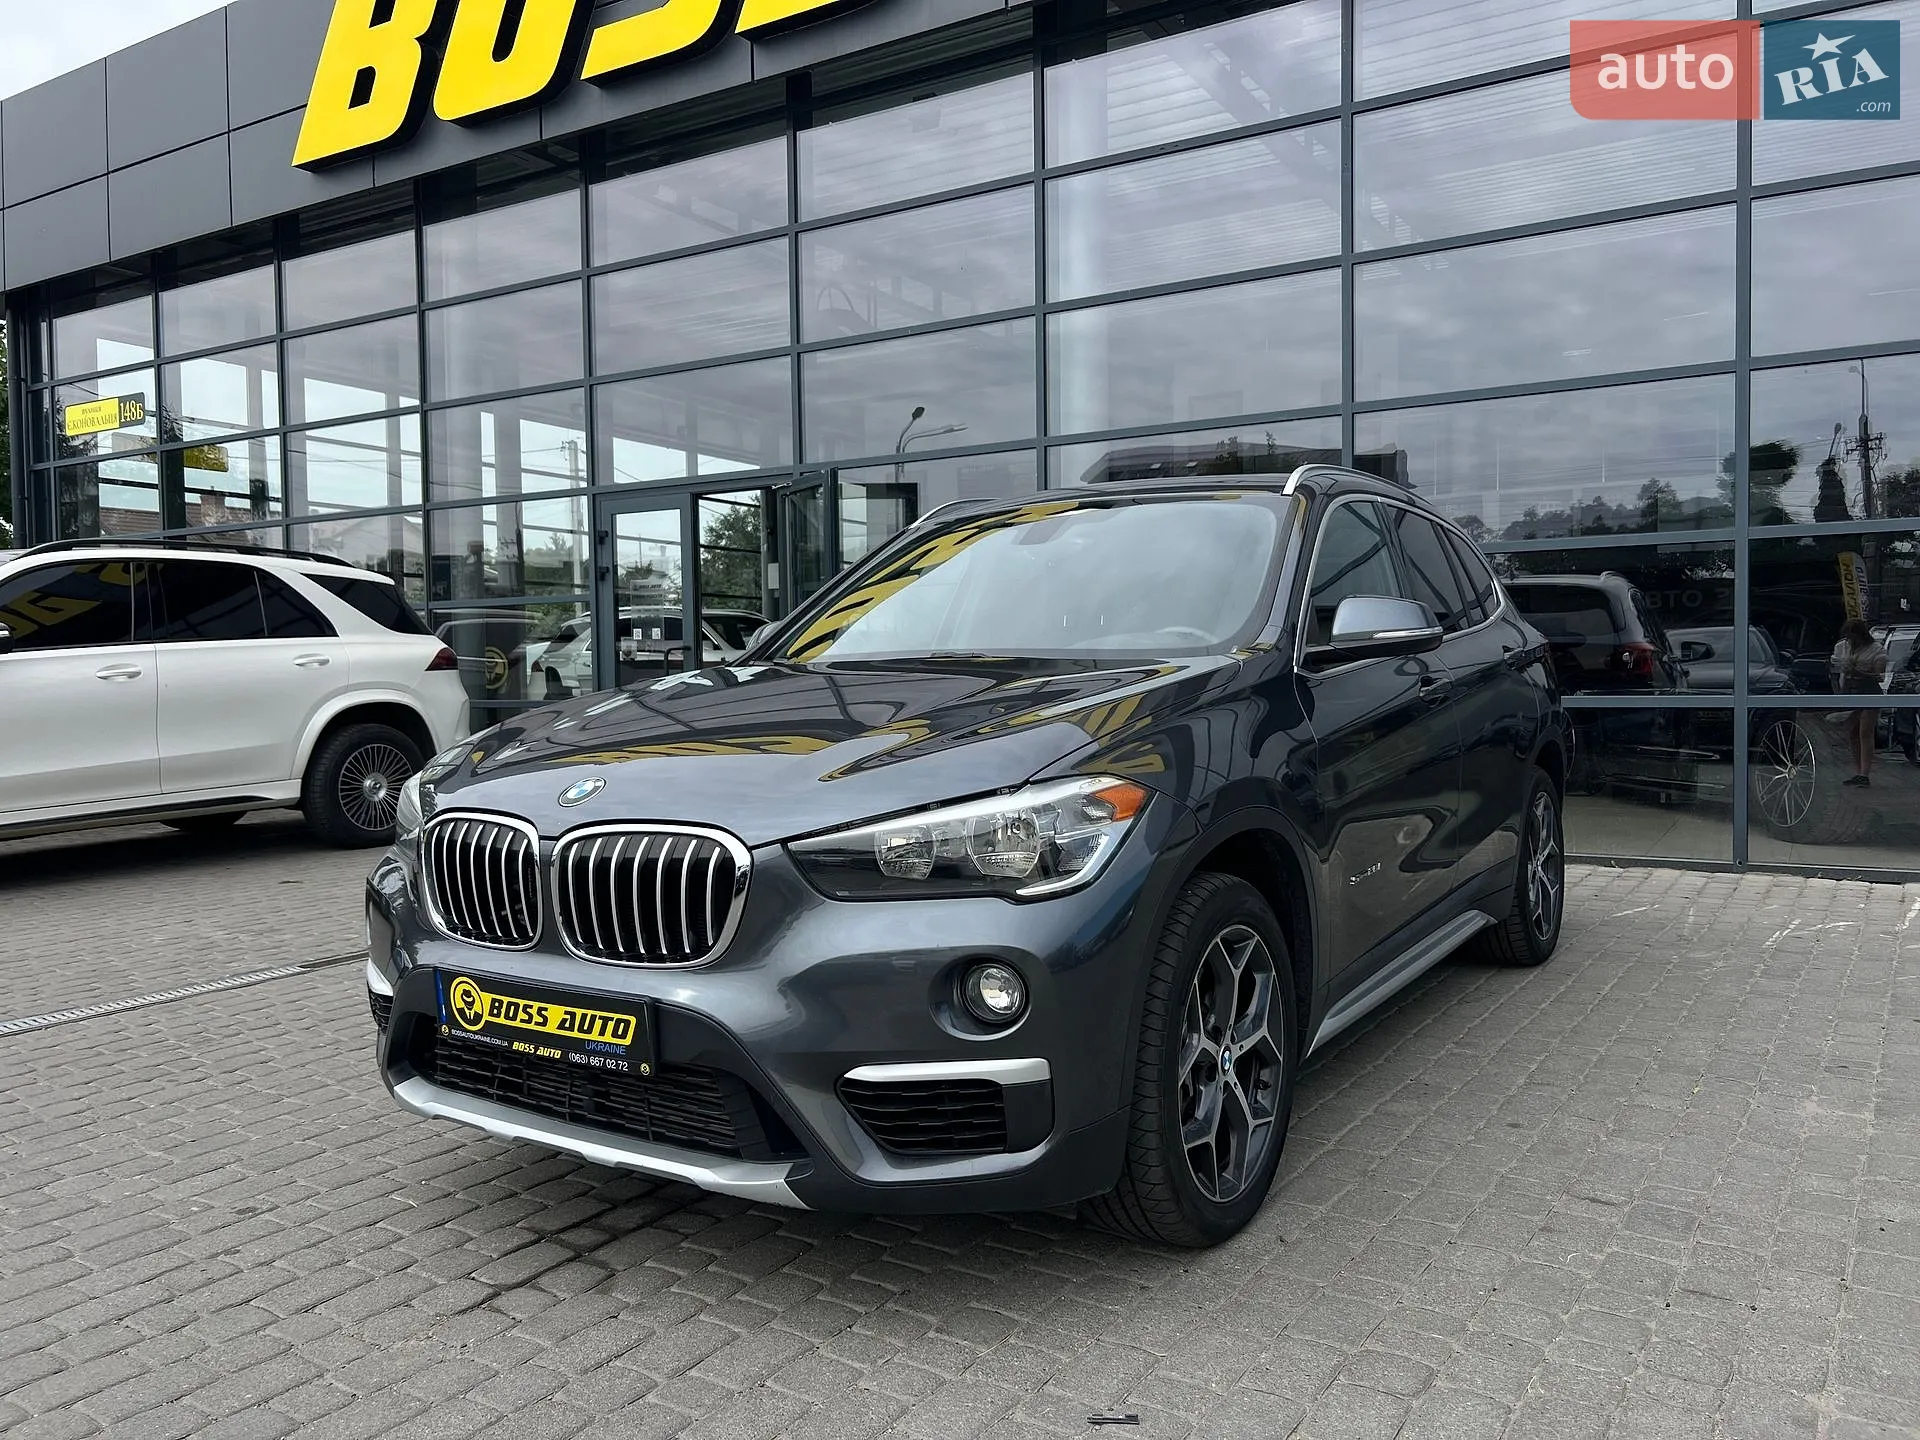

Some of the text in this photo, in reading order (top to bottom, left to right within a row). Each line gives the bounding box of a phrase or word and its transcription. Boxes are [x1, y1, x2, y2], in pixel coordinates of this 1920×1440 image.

[120, 400, 144, 422] 148Б
[488, 998, 631, 1040] BOSS AUTO
[512, 1041, 562, 1059] BOSS AUTO
[585, 1040, 627, 1055] UKRAINE
[568, 1052, 629, 1071] (063) 667 02 72
